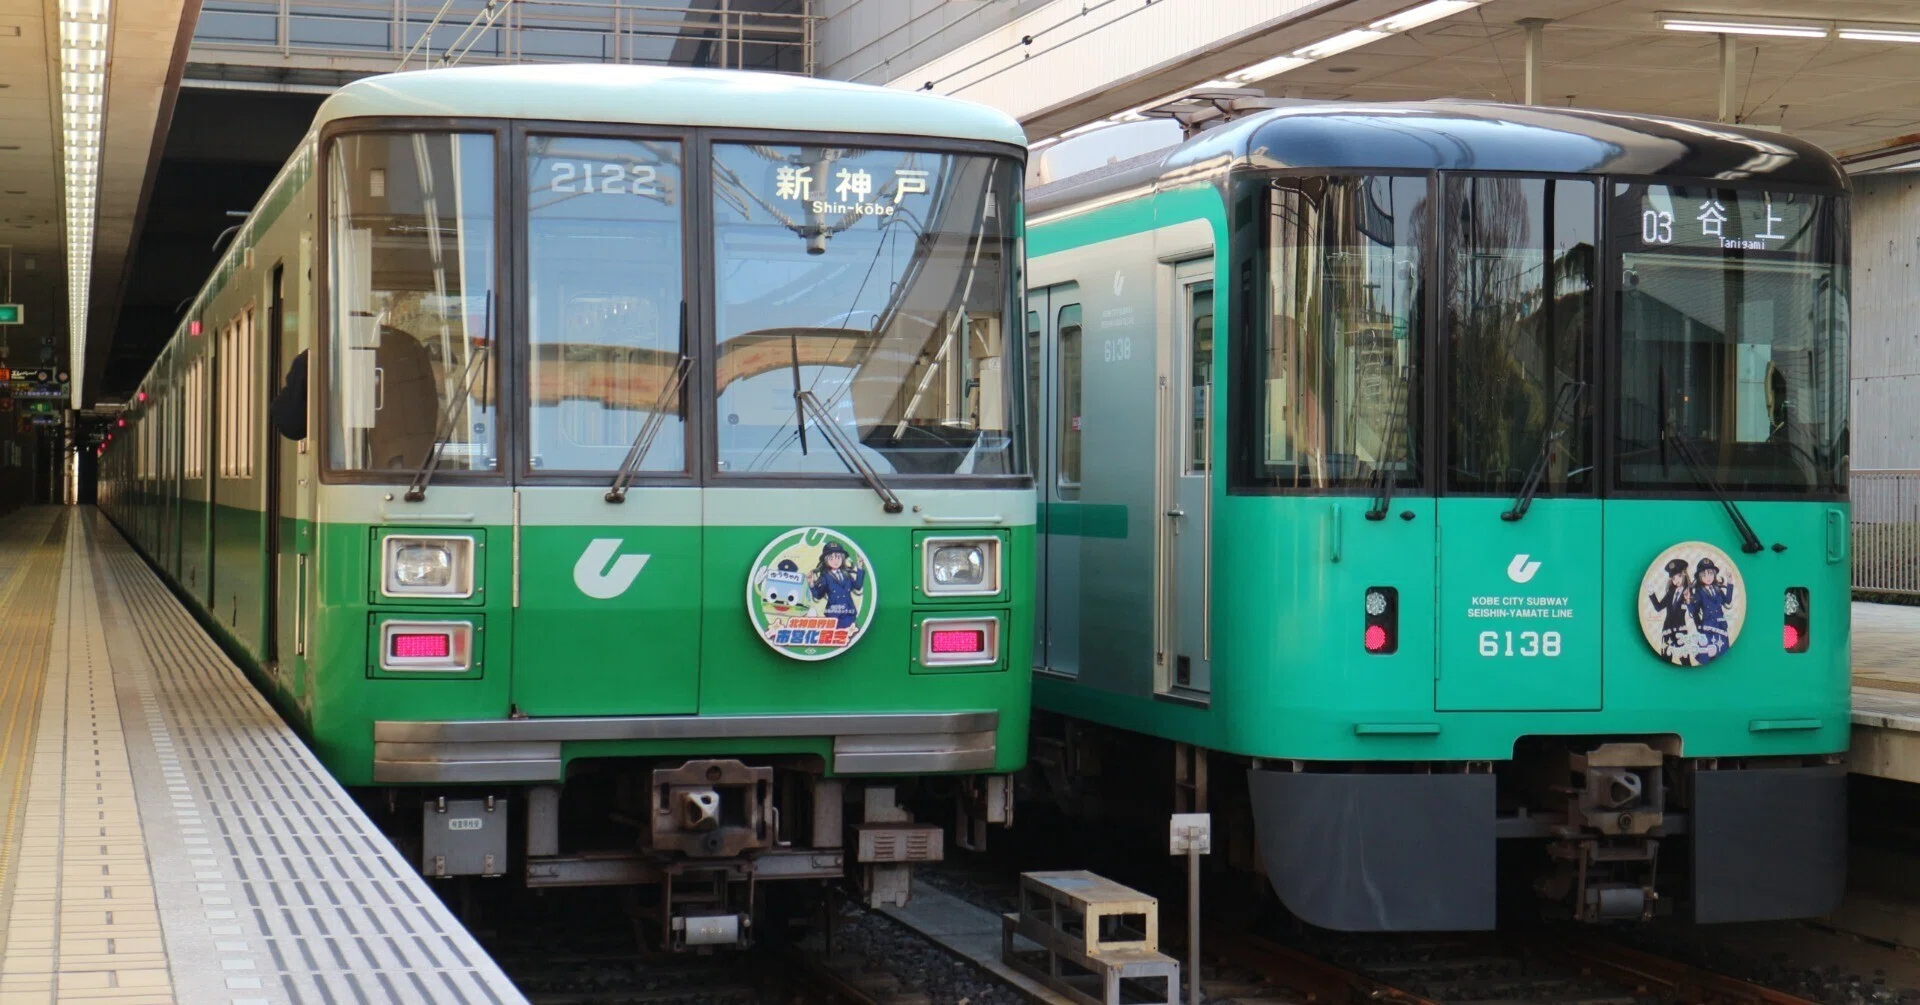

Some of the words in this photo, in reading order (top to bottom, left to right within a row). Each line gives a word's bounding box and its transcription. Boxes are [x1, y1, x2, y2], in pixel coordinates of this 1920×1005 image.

[551, 162, 657, 195] 2122
[776, 165, 929, 204] 新神戸
[812, 200, 894, 216] Shin-kōbe
[1642, 210, 1672, 243] 03
[1697, 200, 1785, 240] 谷上
[1719, 236, 1765, 249] Tanigami
[1105, 337, 1131, 362] 6138
[771, 572, 799, 581] ゆうちゃん
[1472, 597, 1499, 605] KOBE
[1502, 597, 1524, 605] CITY
[1527, 597, 1568, 606] SUBWAY
[1468, 608, 1549, 617] SEISHIN-YAMATE
[1552, 608, 1572, 617] LINE
[776, 630, 849, 644] 市営化記念
[1479, 631, 1561, 657] 6138
